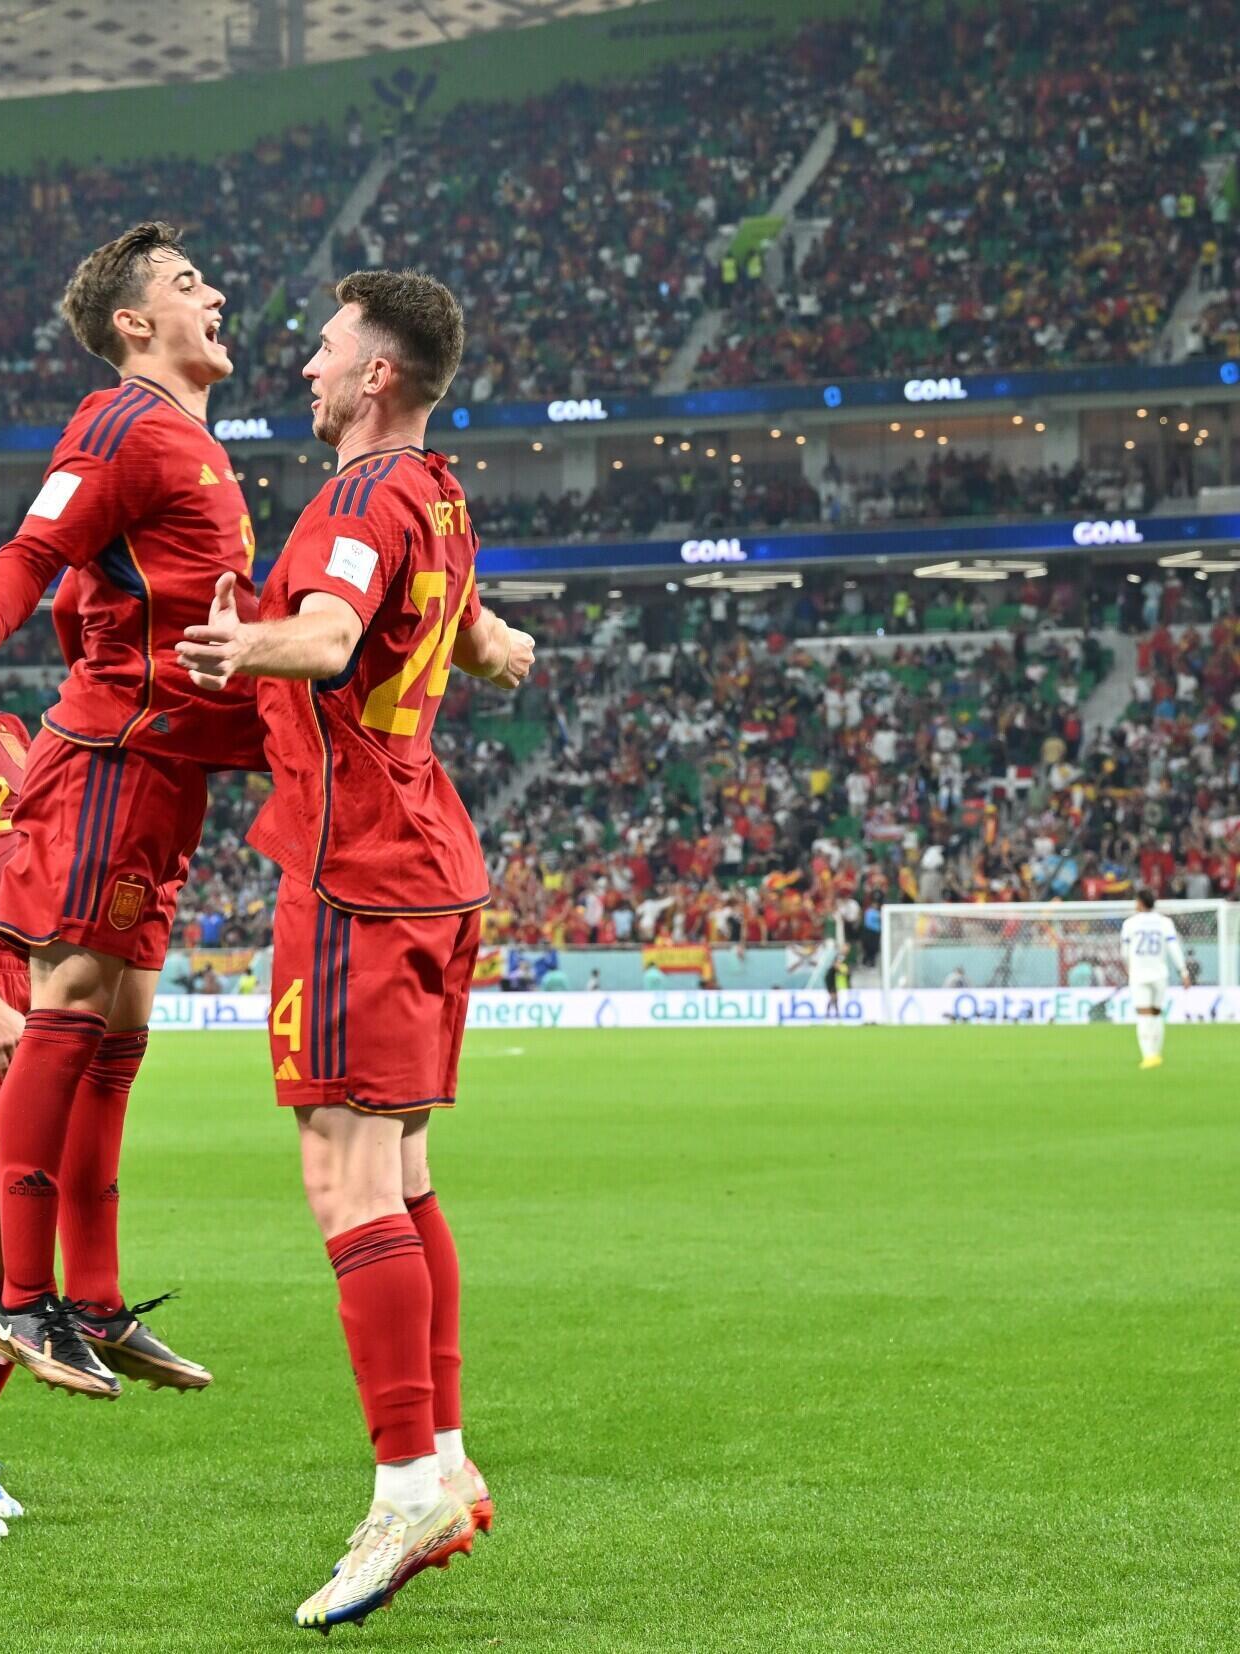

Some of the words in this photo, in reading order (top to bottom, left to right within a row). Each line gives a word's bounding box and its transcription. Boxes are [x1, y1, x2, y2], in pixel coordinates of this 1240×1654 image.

[903, 377, 967, 402] GOAL
[547, 398, 608, 422] GOAL
[214, 417, 274, 440] GOAL
[1072, 519, 1144, 546] GOAL
[680, 537, 748, 563] GOAL
[1135, 929, 1162, 956] 26
